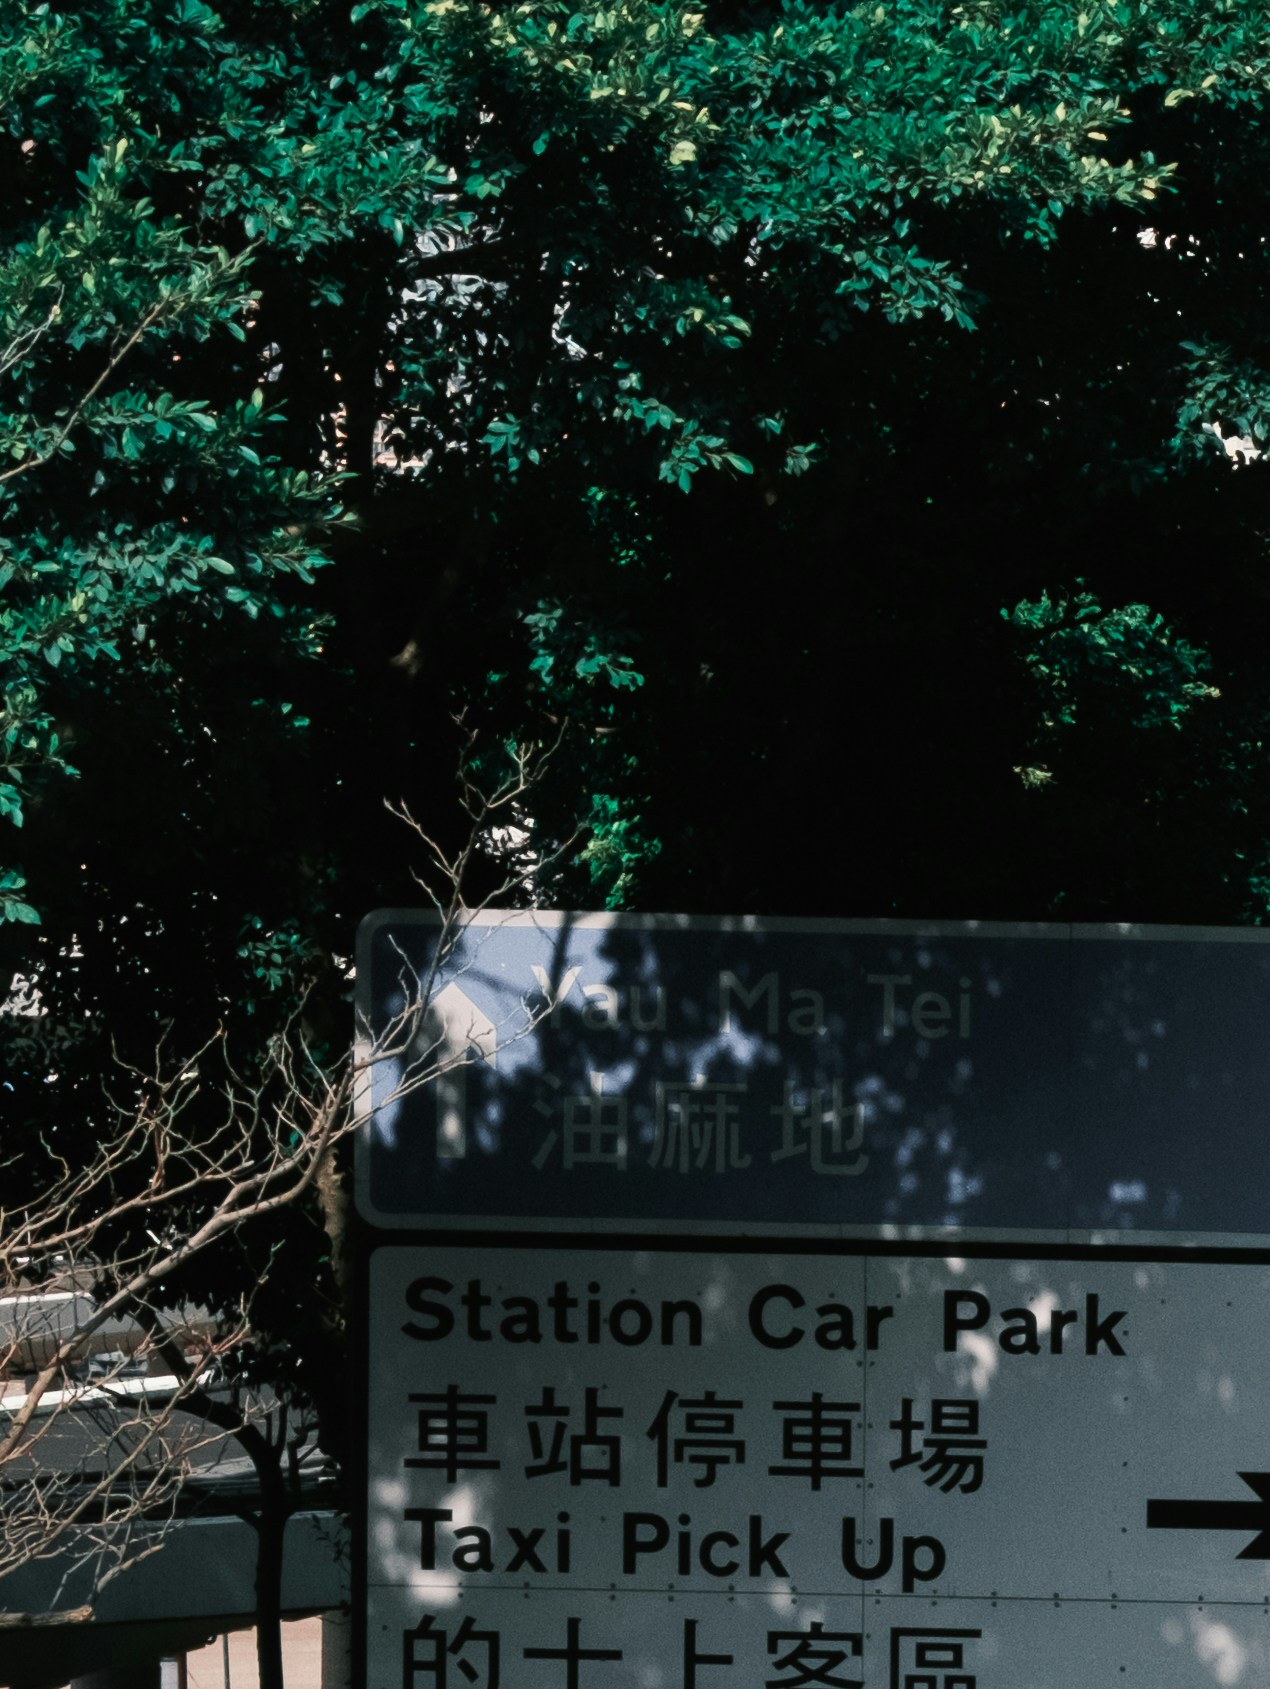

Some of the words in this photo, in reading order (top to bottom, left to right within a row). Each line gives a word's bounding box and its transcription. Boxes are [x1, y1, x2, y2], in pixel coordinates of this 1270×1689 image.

[535, 965, 669, 1032] Yau
[720, 972, 827, 1037] Ma
[868, 974, 974, 1039] Tei
[531, 1072, 869, 1177] 油麻地
[401, 1276, 704, 1347] Station
[748, 1284, 894, 1351] Car
[943, 1288, 1128, 1356] Park
[404, 1384, 989, 1495] 車站停車場
[404, 1508, 572, 1574] Taxi
[623, 1514, 792, 1579] Pick
[840, 1518, 947, 1593] Up
